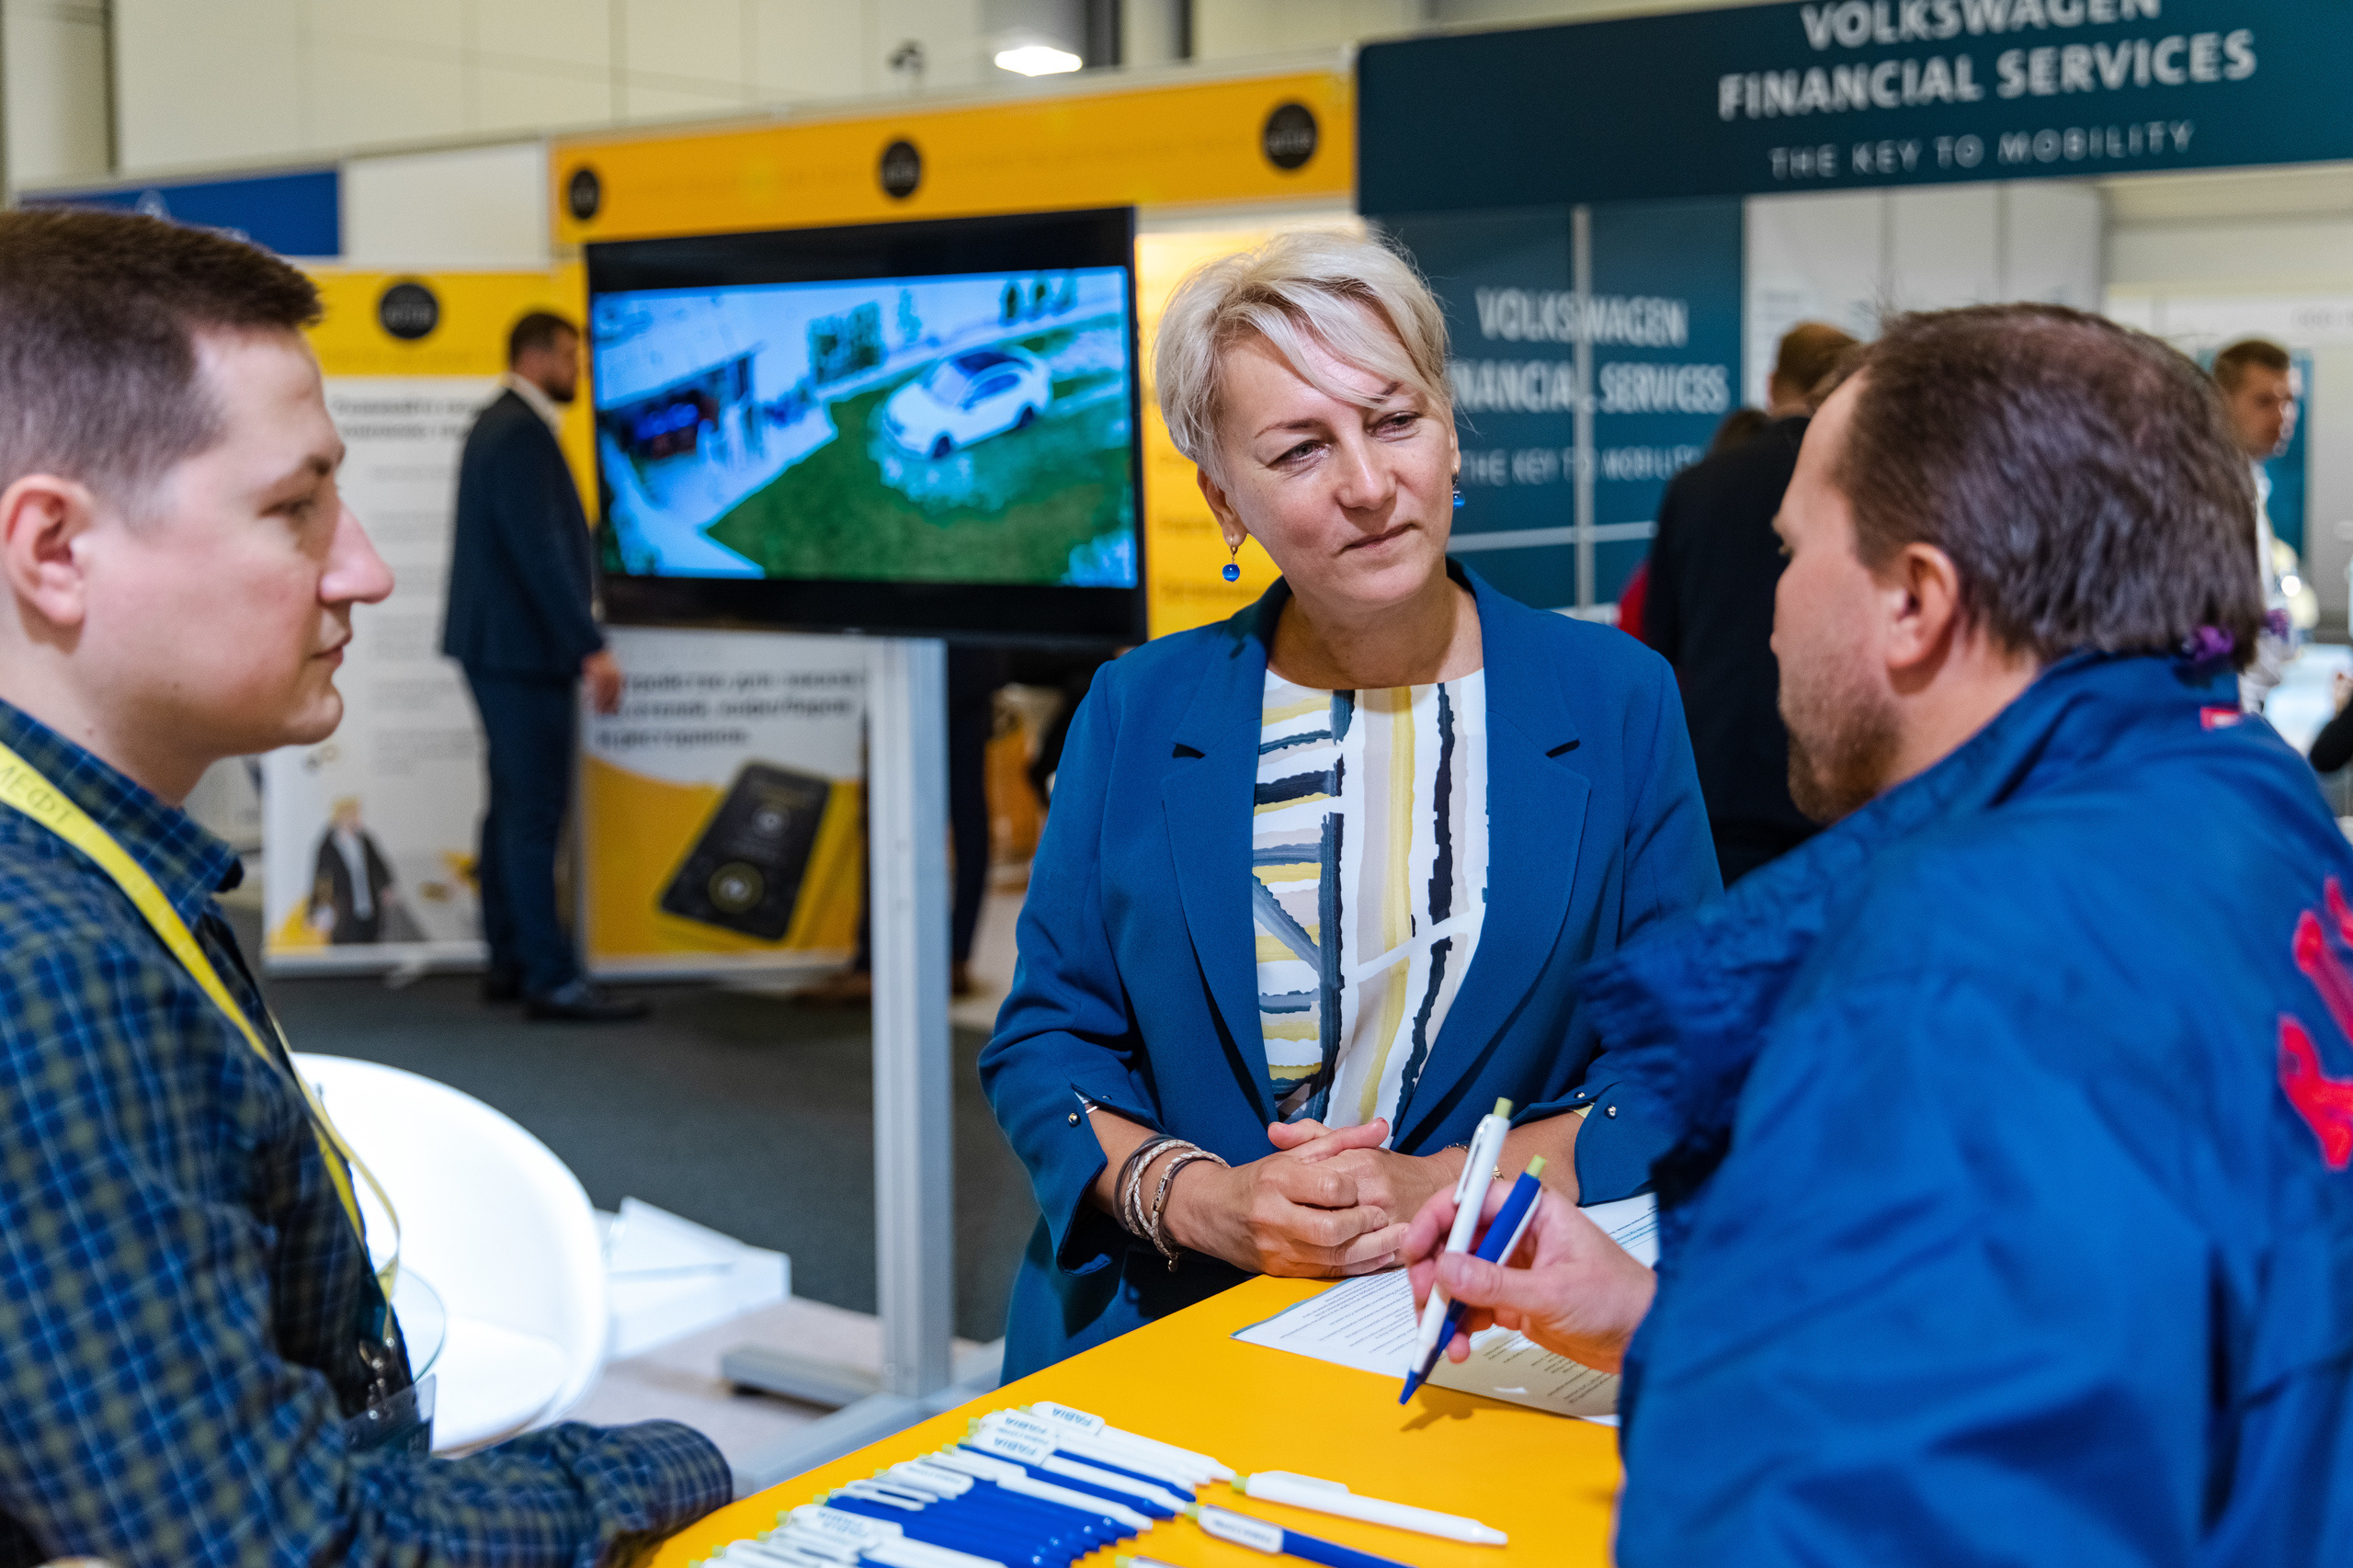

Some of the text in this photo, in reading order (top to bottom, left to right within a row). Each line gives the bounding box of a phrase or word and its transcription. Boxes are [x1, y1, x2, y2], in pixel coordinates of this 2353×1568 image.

[1717, 29, 2256, 121] FINANCIAL SERVICES
[1768, 119, 2194, 179] THE KEY TO MOBILITY
[1476, 288, 1688, 347] VOLKSWAGEN
[1599, 362, 1729, 414] SERVICES
[1005, 1416, 1048, 1435] FABIA
[1052, 1407, 1093, 1426] FABIA
[994, 1437, 1038, 1457] FABIA
